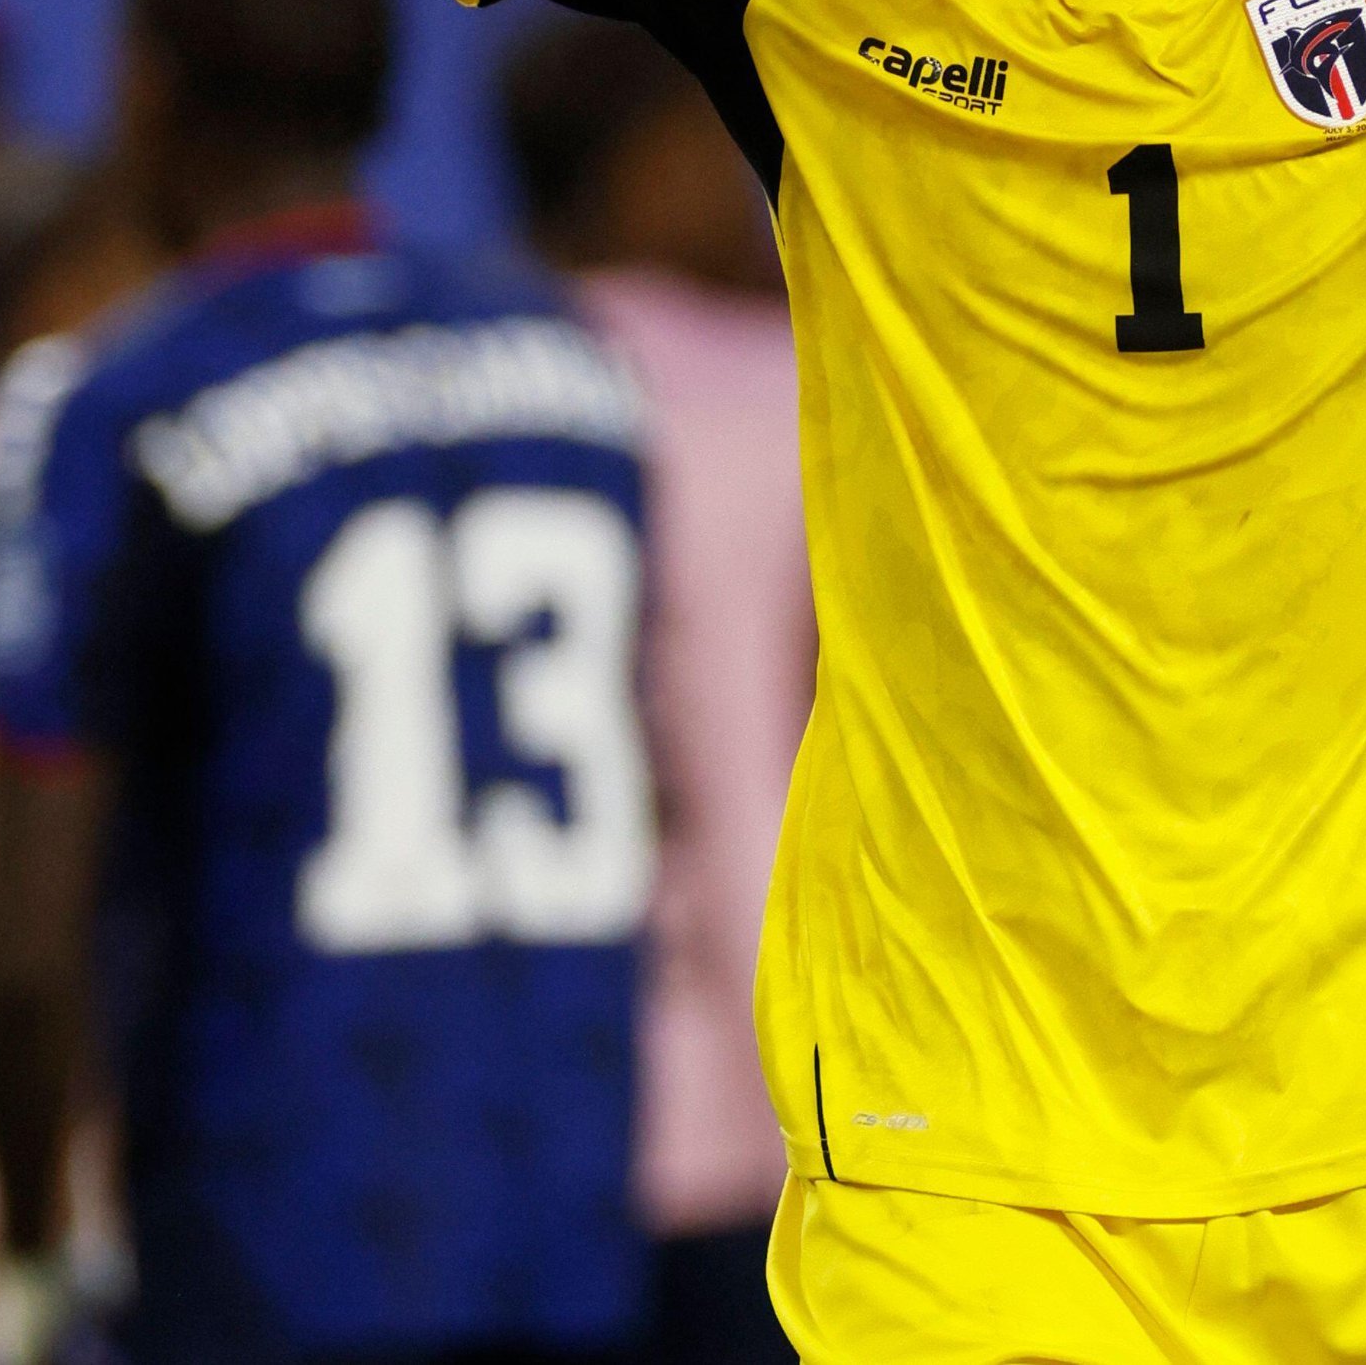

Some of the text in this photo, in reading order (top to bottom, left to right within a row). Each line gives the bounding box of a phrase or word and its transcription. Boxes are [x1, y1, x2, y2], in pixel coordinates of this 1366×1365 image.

[858, 36, 1009, 101] capelli
[1107, 143, 1205, 353] 1
[292, 482, 662, 957] 13
